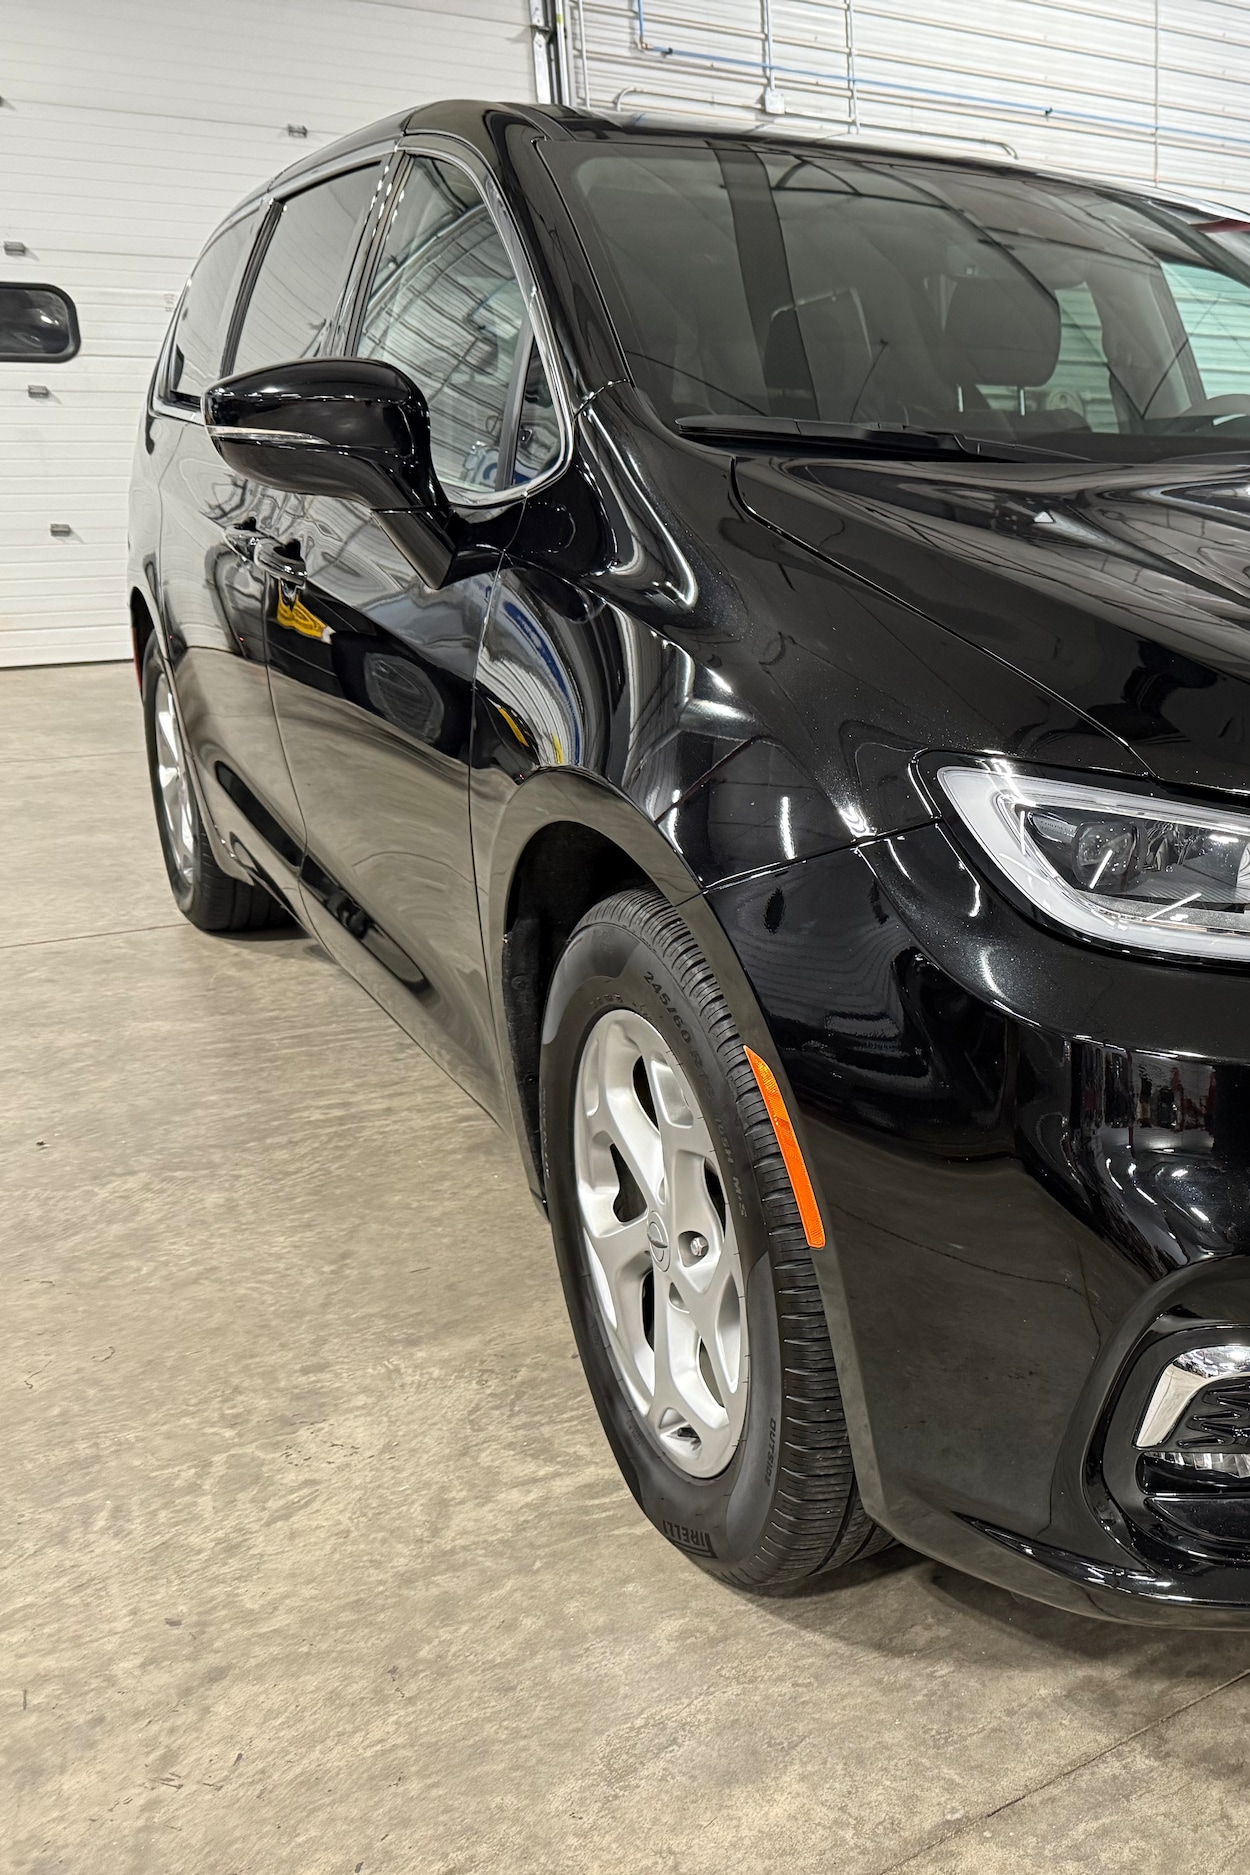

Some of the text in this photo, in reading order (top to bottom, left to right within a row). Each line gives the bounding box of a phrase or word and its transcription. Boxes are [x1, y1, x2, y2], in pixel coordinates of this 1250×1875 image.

[643, 971, 692, 1044] 245/60
[764, 1417, 777, 1487] OUTSIDE
[662, 1519, 718, 1559] PIRELLI
